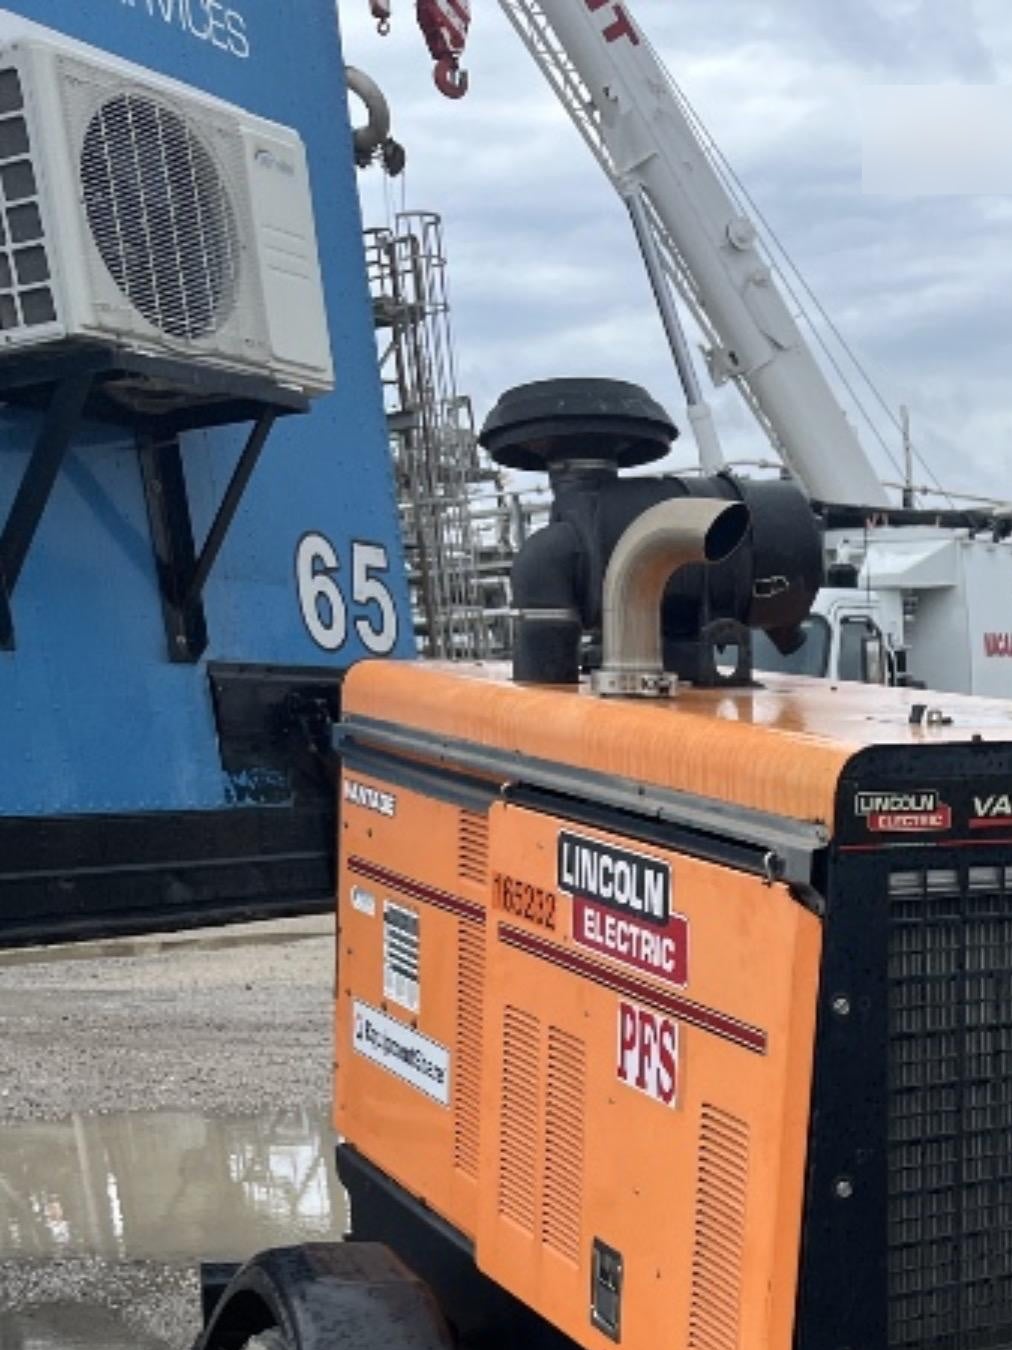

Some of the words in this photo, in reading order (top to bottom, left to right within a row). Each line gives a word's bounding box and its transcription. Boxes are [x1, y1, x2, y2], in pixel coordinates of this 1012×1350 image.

[295, 530, 398, 656] 65
[859, 794, 935, 812] LINCOLN
[878, 813, 945, 829] ELECTRIC
[562, 842, 665, 919] LINCOLN
[583, 905, 676, 973] ELECTRIC
[616, 1001, 677, 1105] PFS
